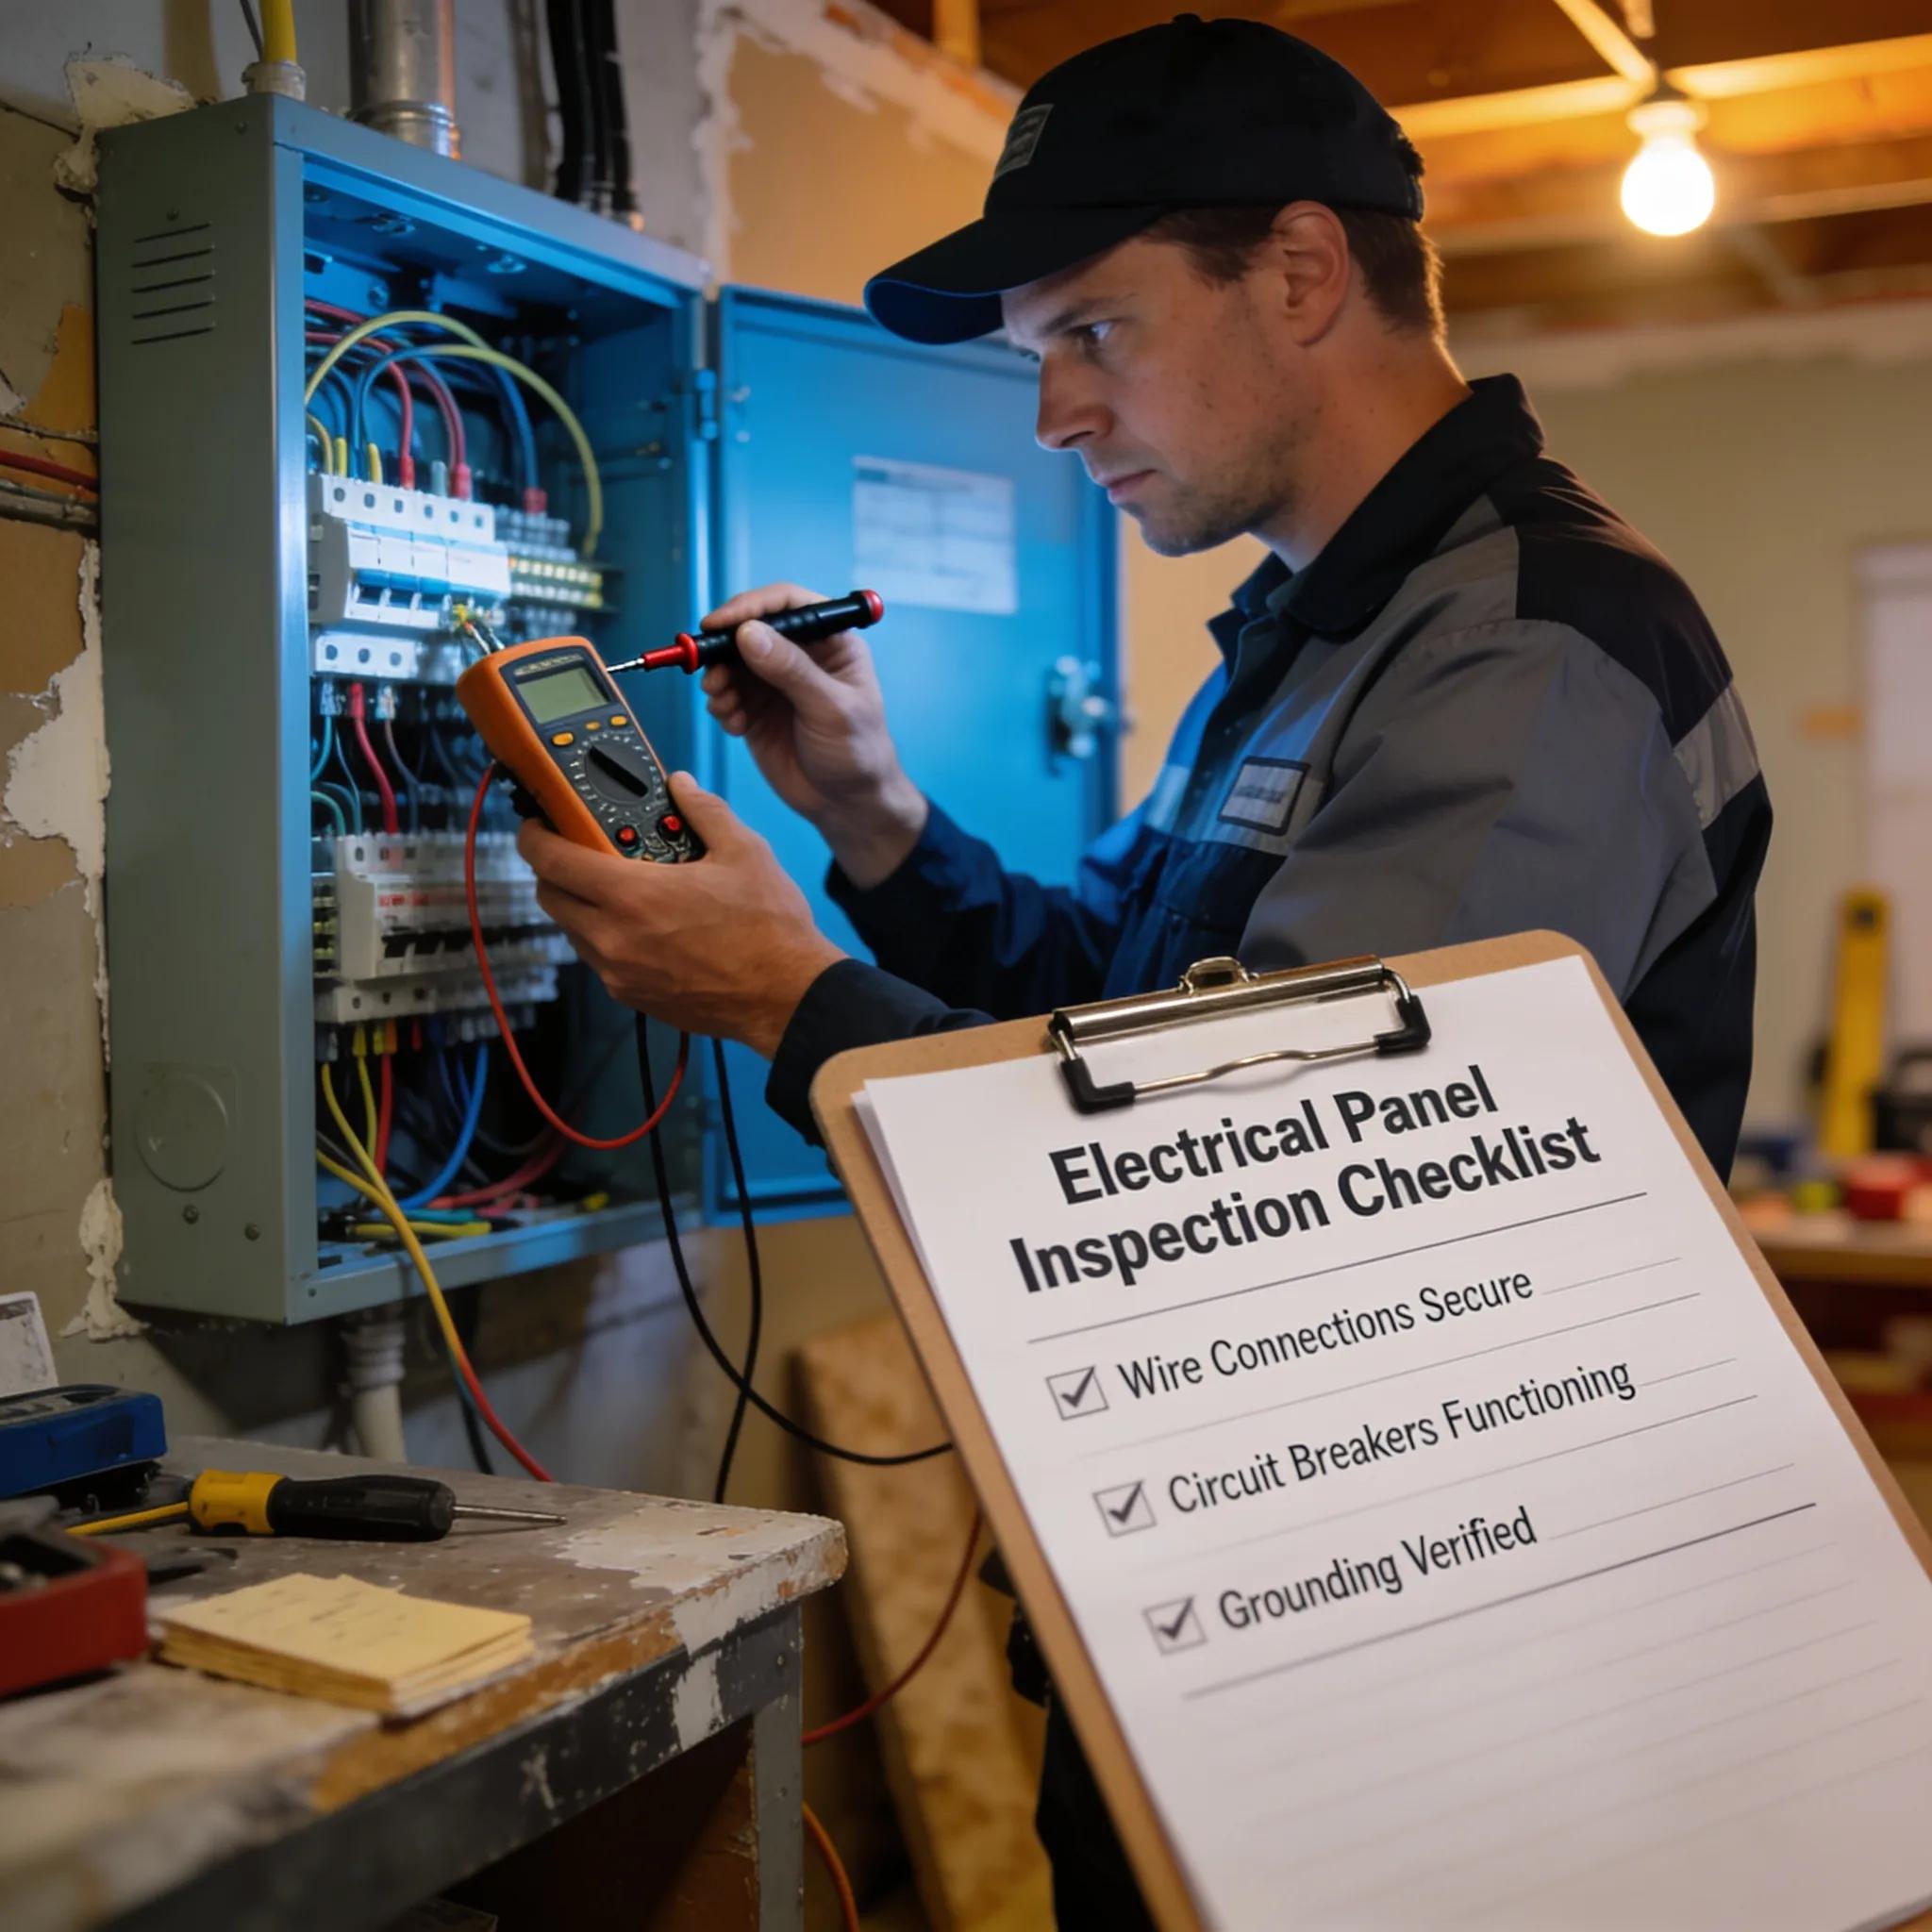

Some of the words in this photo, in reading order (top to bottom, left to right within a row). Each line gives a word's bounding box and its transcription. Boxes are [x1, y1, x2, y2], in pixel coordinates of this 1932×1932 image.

[1008, 1189, 1331, 1293] Inspection
[1337, 1117, 1601, 1217] Checklist
[1048, 1099, 1330, 1206] Electrical
[1332, 1064, 1499, 1142] Panel
[1117, 1355, 1204, 1399] Wire
[1210, 1303, 1415, 1376] Connections
[1419, 1274, 1533, 1323] Secure
[1169, 1453, 1286, 1513] Circuit
[1287, 1418, 1439, 1481] Breakers
[1441, 1362, 1637, 1440] Functioning
[1219, 1555, 1403, 1629] Grounding
[1401, 1505, 1538, 1575] Verified
